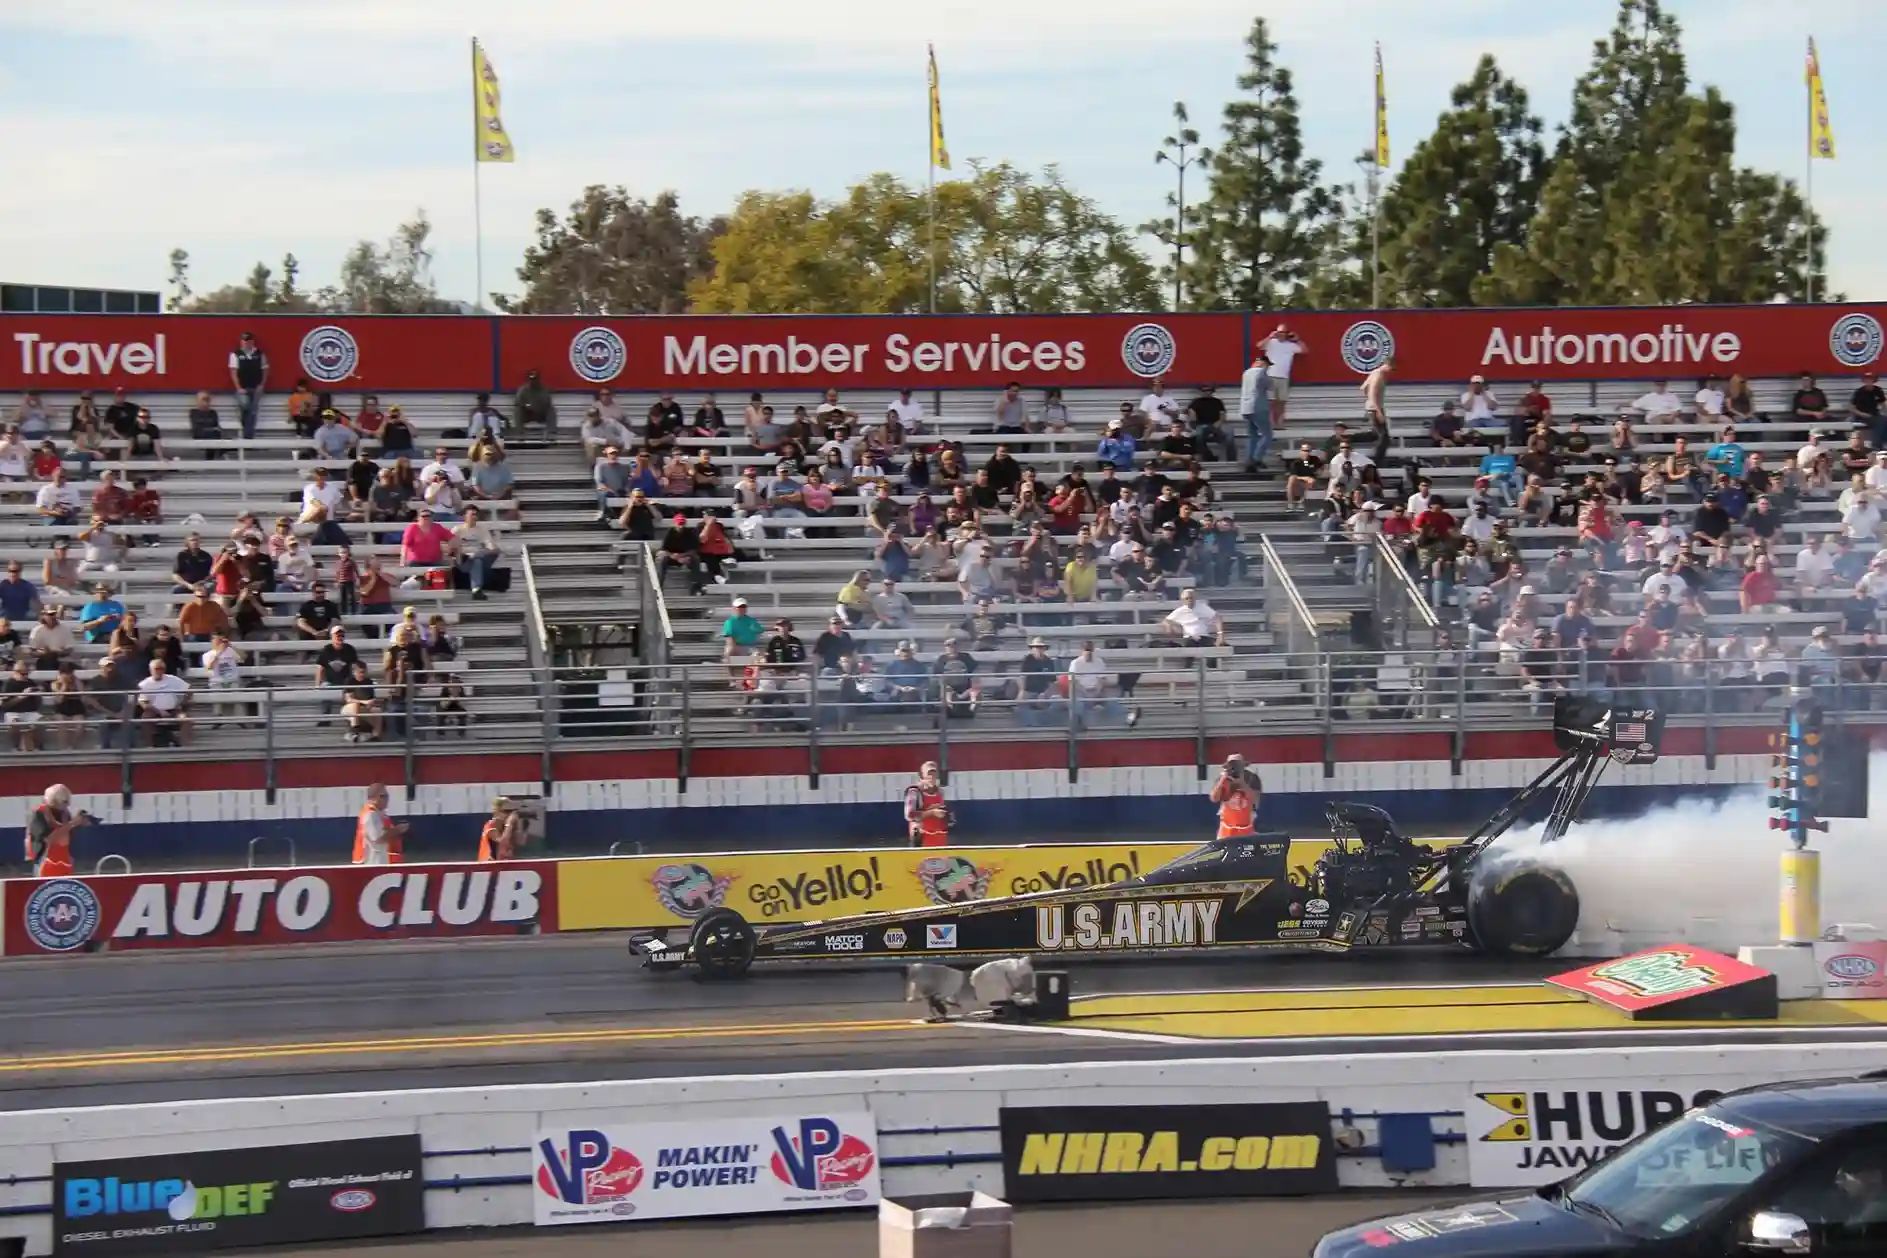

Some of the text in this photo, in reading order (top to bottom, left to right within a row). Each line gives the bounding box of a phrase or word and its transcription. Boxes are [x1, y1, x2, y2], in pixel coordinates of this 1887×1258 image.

[13, 332, 167, 375] Travel
[663, 333, 1087, 375] Member Services
[1480, 324, 1741, 366] Automotive
[112, 869, 543, 938] AUTO CLUB
[749, 883, 780, 903] Go
[777, 856, 883, 910] Yello!
[1011, 876, 1041, 895] Go
[761, 899, 789, 917] on
[1036, 900, 1223, 950] U.S.ARMY
[824, 935, 864, 943] MATCO
[825, 942, 864, 951] TOOLS
[886, 933, 905, 944] NAPA
[1534, 1089, 1724, 1141] HUR
[539, 1129, 610, 1205] VP
[657, 1144, 759, 1167] MAKIN'
[770, 1117, 840, 1190] VP
[1018, 1131, 1320, 1175] NHRA.com
[652, 1166, 757, 1190] POWER!
[62, 1222, 217, 1243] DIESEL EXHAUST FLUID
